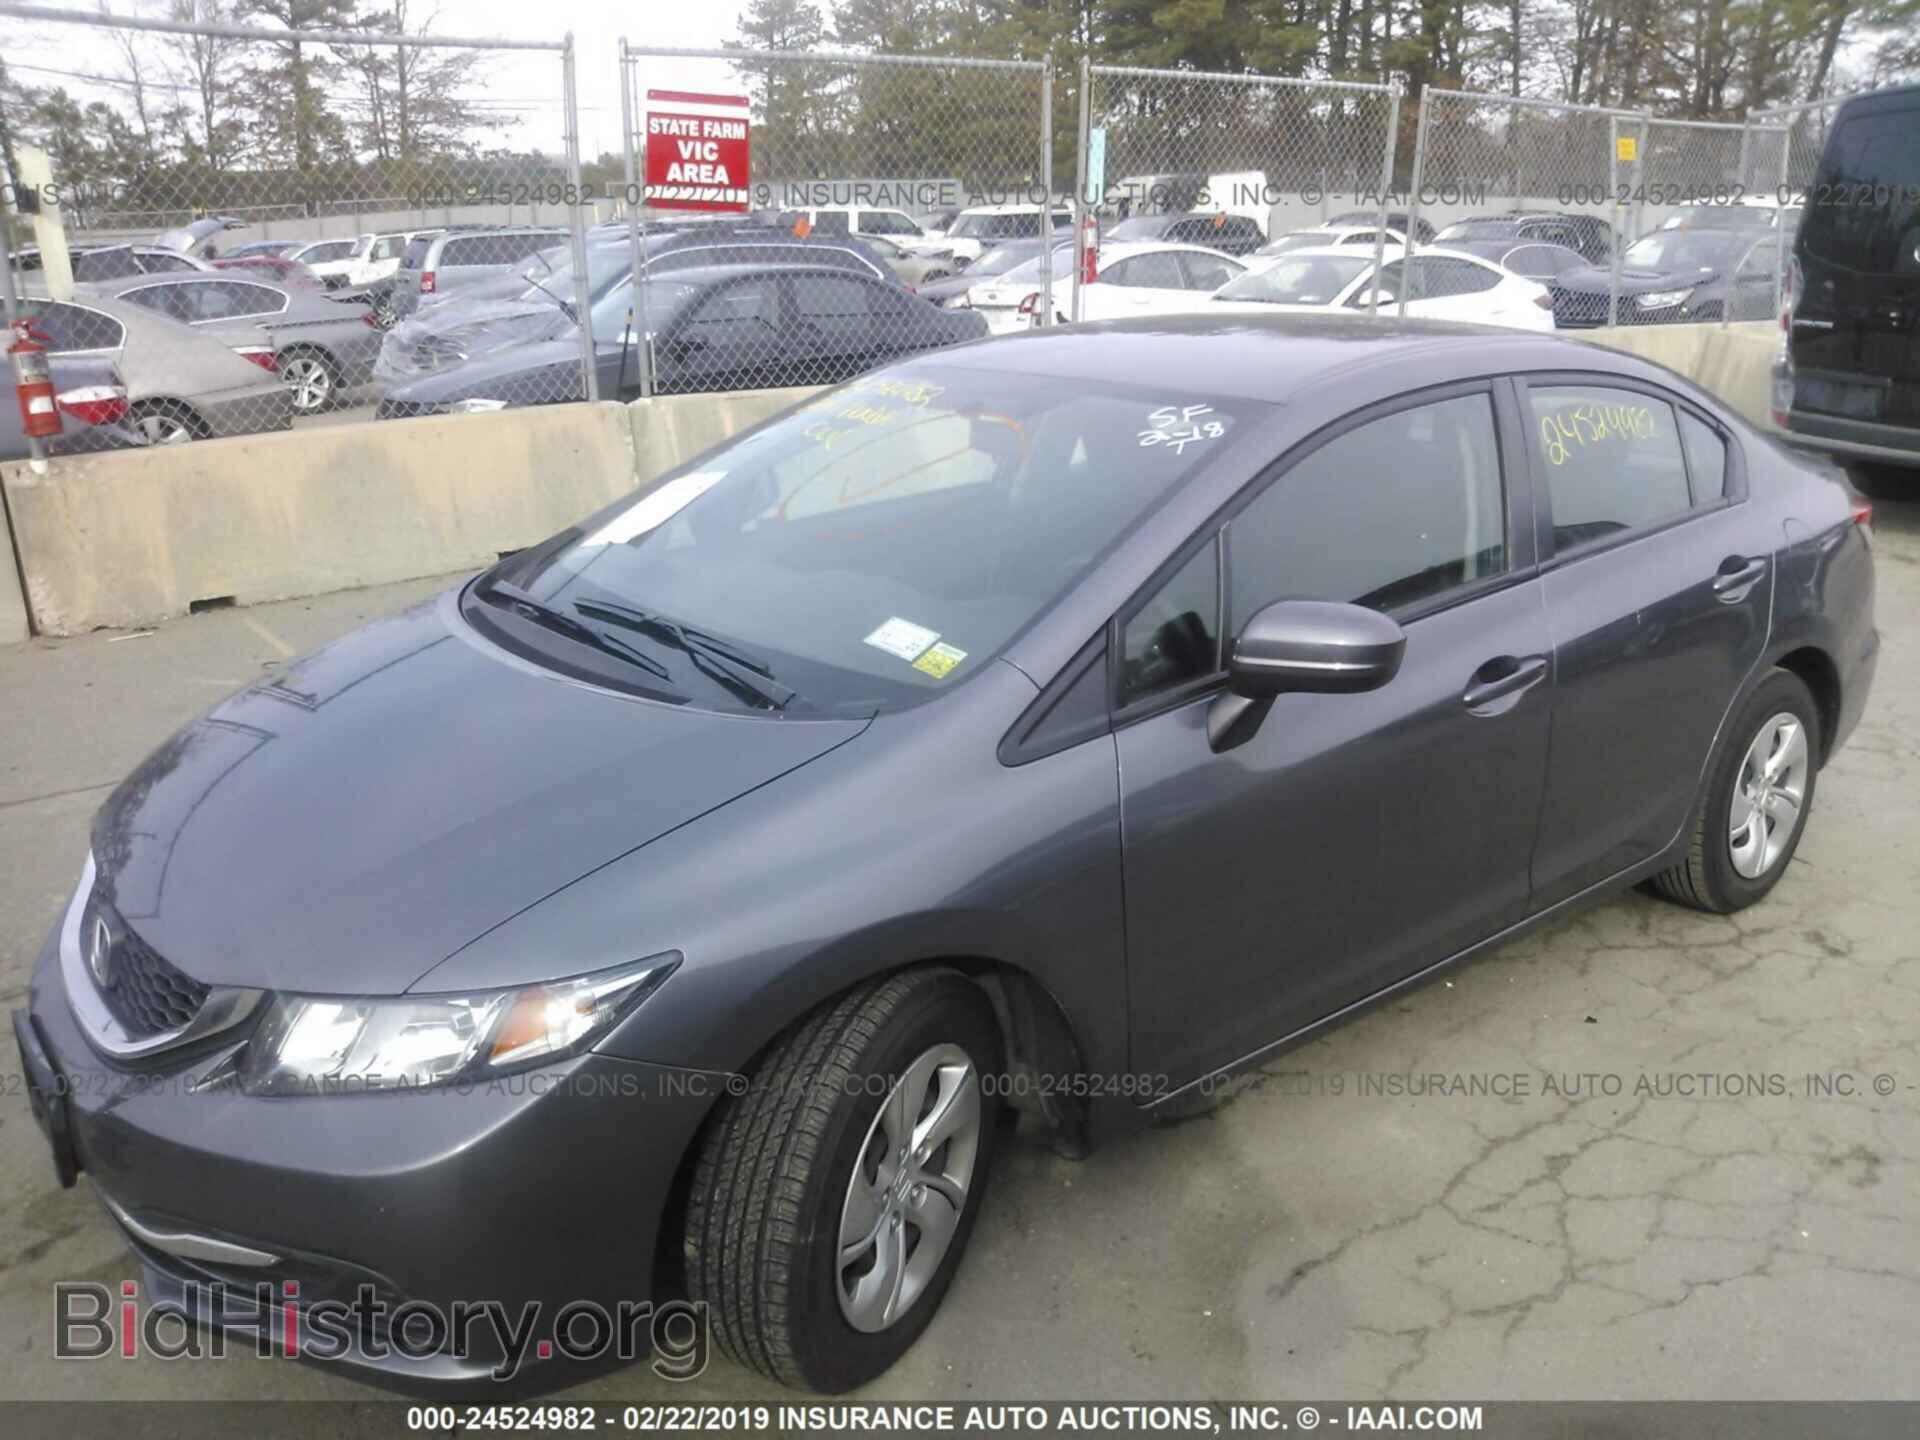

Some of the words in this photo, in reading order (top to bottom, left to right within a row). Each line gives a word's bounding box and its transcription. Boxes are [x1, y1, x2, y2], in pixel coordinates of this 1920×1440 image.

[649, 117, 700, 137] STATE
[703, 120, 746, 140] FARM
[677, 139, 719, 161] VIC
[666, 162, 730, 185] AREA
[1147, 403, 1215, 429] SF
